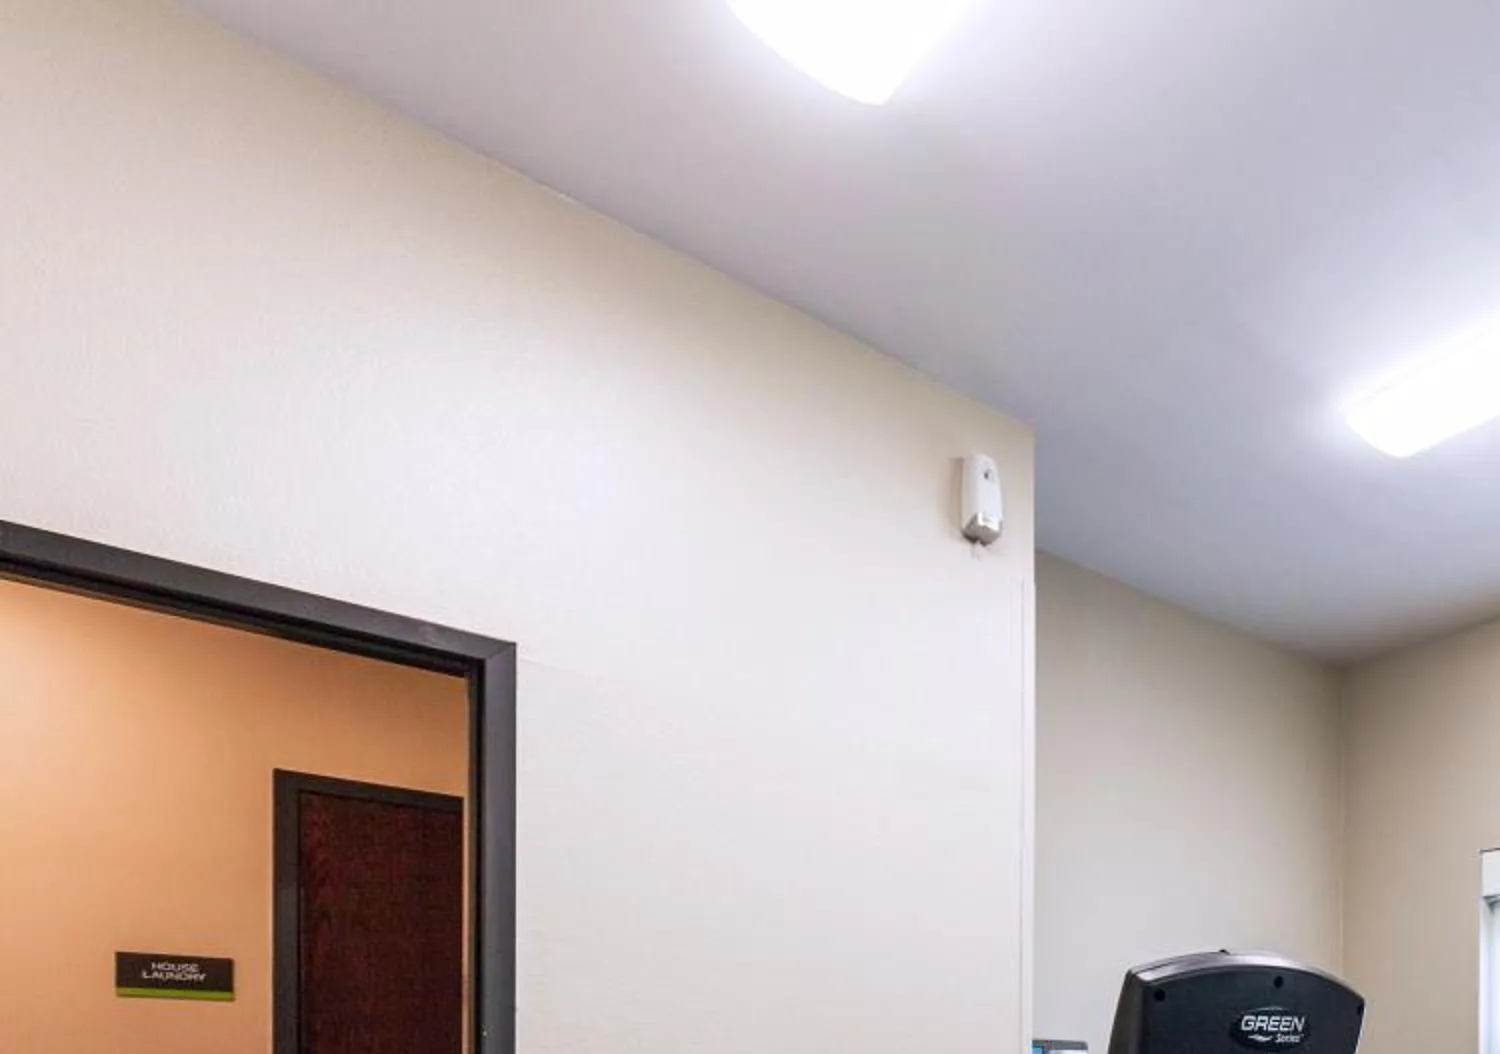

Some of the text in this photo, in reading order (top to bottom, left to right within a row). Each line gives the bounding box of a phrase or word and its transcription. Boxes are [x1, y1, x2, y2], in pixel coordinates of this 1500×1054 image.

[151, 962, 199, 973] HOUSE
[142, 970, 207, 982] LAUNDRY
[1240, 1015, 1305, 1032] GREEN
